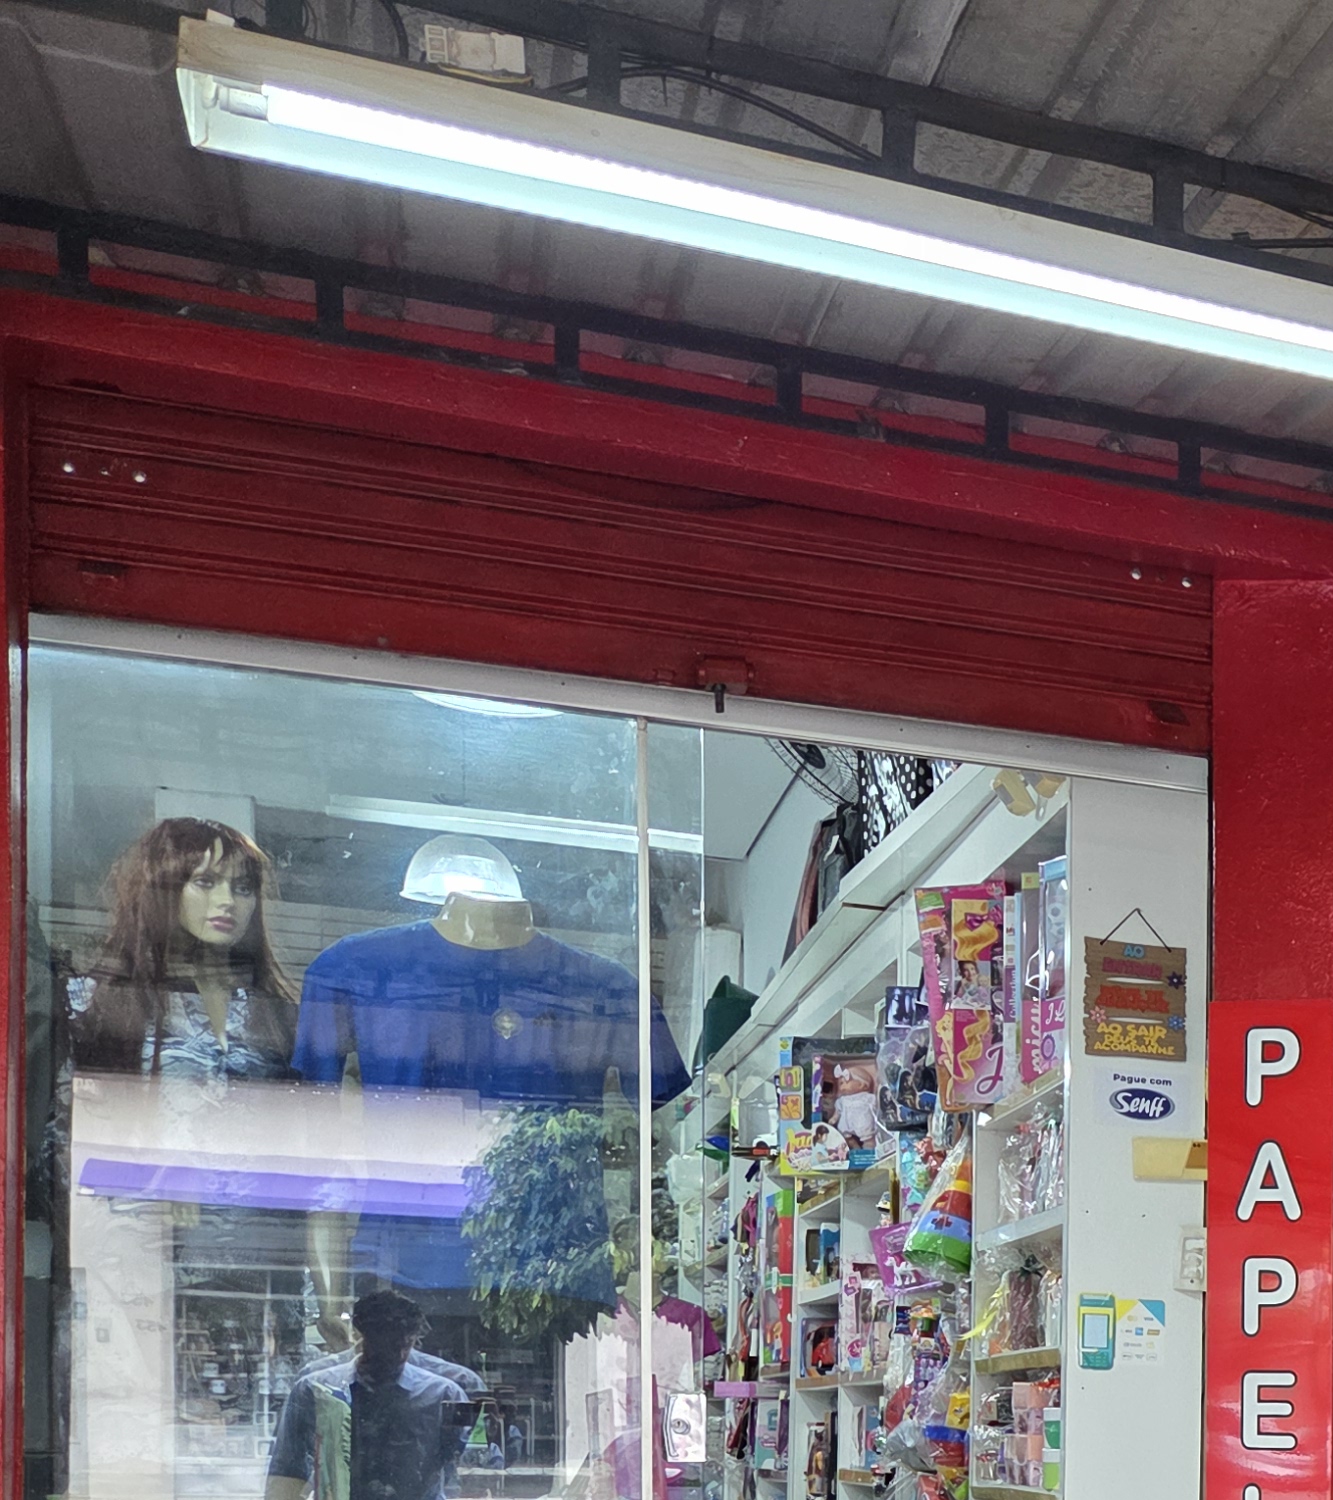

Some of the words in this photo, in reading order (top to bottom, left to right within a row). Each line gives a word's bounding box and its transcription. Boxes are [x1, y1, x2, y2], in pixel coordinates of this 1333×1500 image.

[1123, 944, 1145, 958] AO
[1096, 1022, 1123, 1035] AO
[1126, 1024, 1168, 1039] SAIR
[1093, 1041, 1176, 1056] ACOMPANHE
[1113, 1073, 1147, 1084] Pague
[1149, 1078, 1172, 1086] com
[1115, 1092, 1167, 1117] Senff
